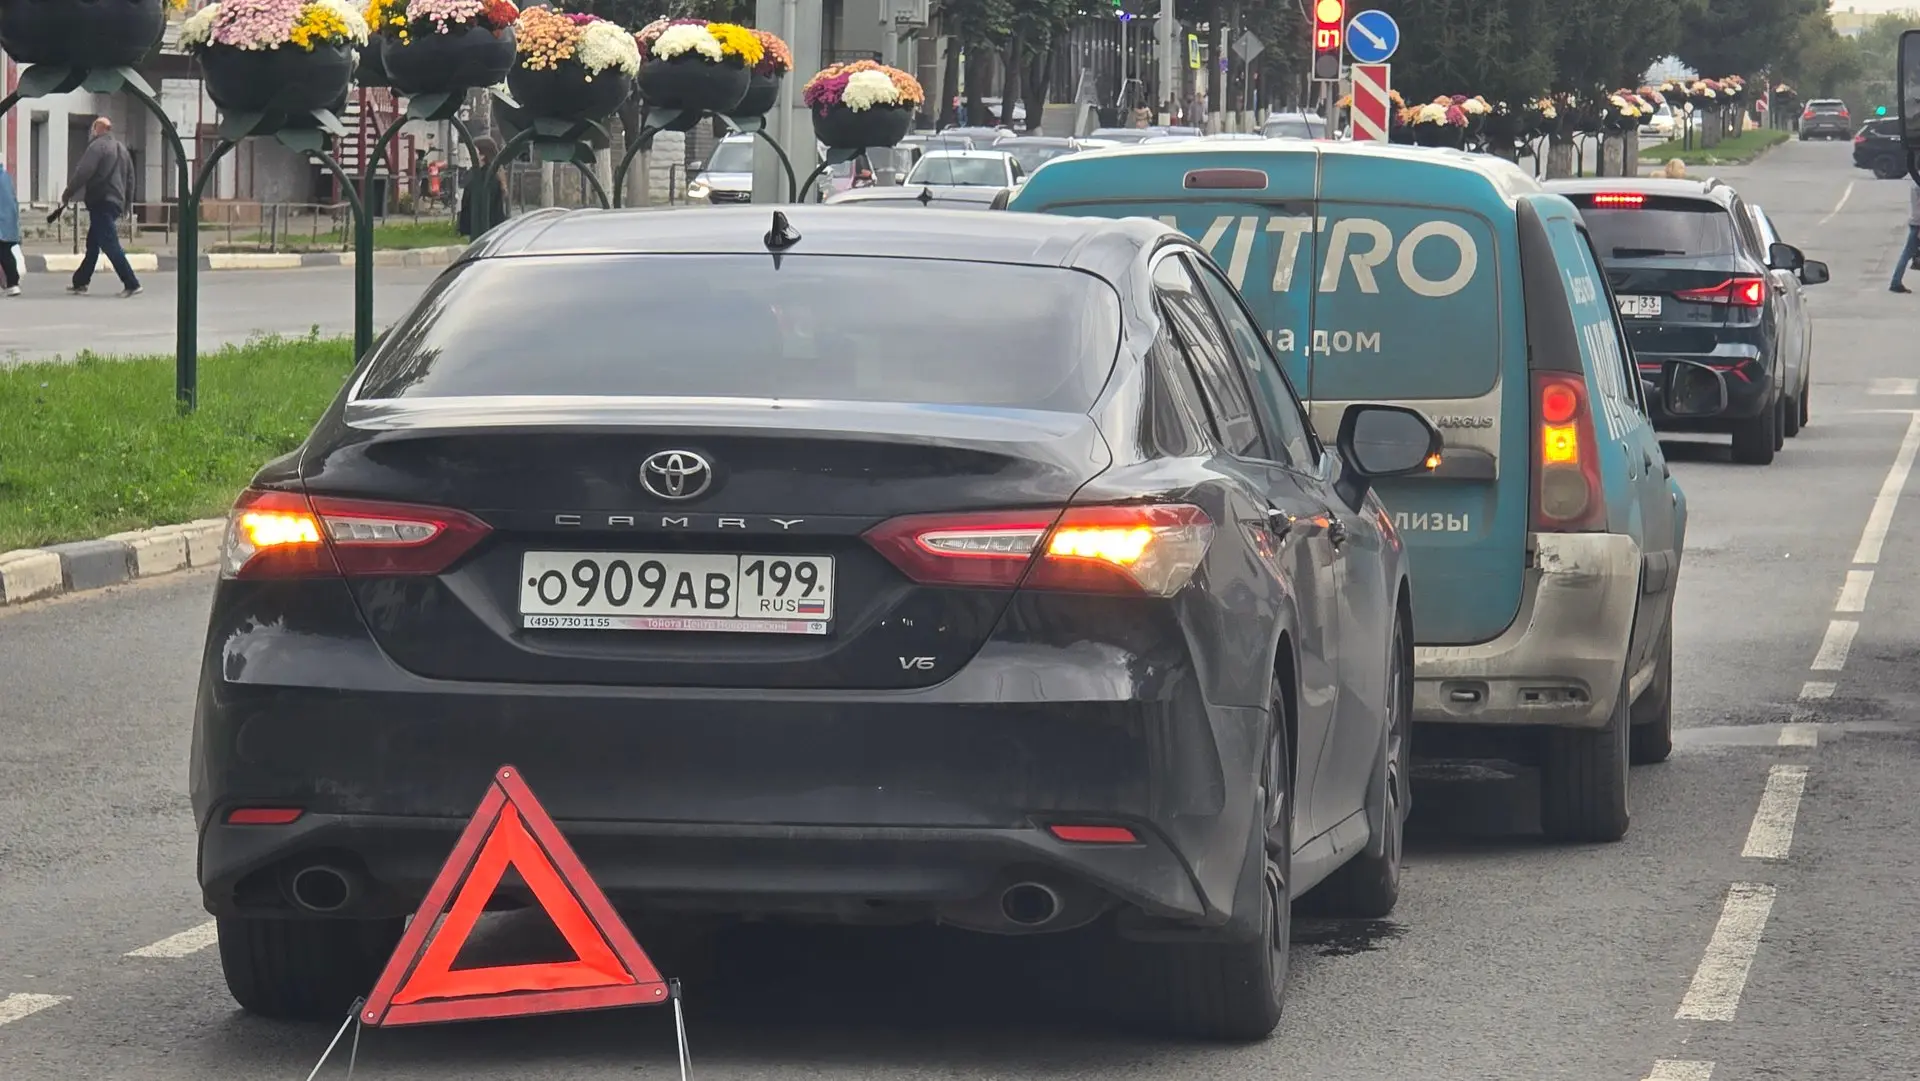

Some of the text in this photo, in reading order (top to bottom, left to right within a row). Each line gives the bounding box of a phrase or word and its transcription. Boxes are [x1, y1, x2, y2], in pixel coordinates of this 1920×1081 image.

[1305, 329, 1381, 357] дом
[555, 514, 803, 530] CAMRY
[1394, 512, 1469, 532] лизы
[744, 560, 818, 597] 199
[760, 599, 796, 612] RUS
[530, 617, 559, 627] (495)
[562, 617, 581, 627] 730
[899, 657, 936, 669] V6
